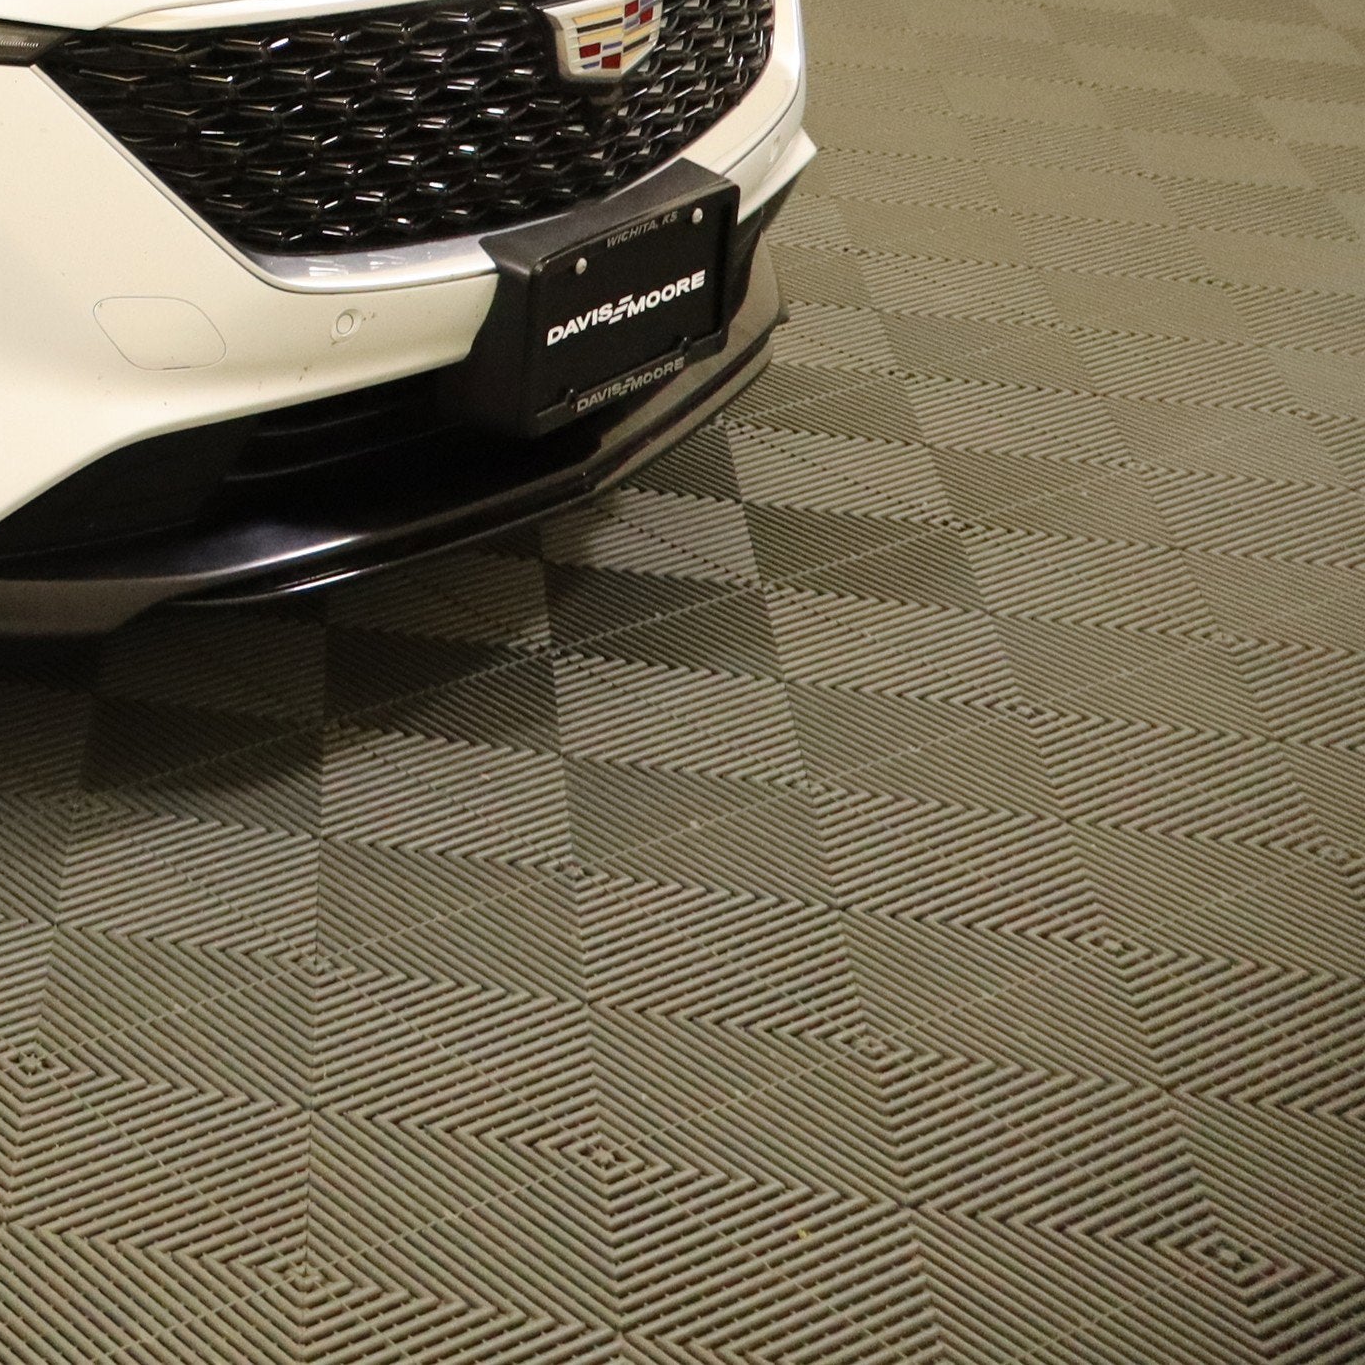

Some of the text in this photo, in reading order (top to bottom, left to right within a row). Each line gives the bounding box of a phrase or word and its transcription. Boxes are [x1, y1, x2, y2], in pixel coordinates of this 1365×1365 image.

[546, 269, 706, 347] DAVIS MOORE
[576, 356, 686, 413] DAVIS MOORE
